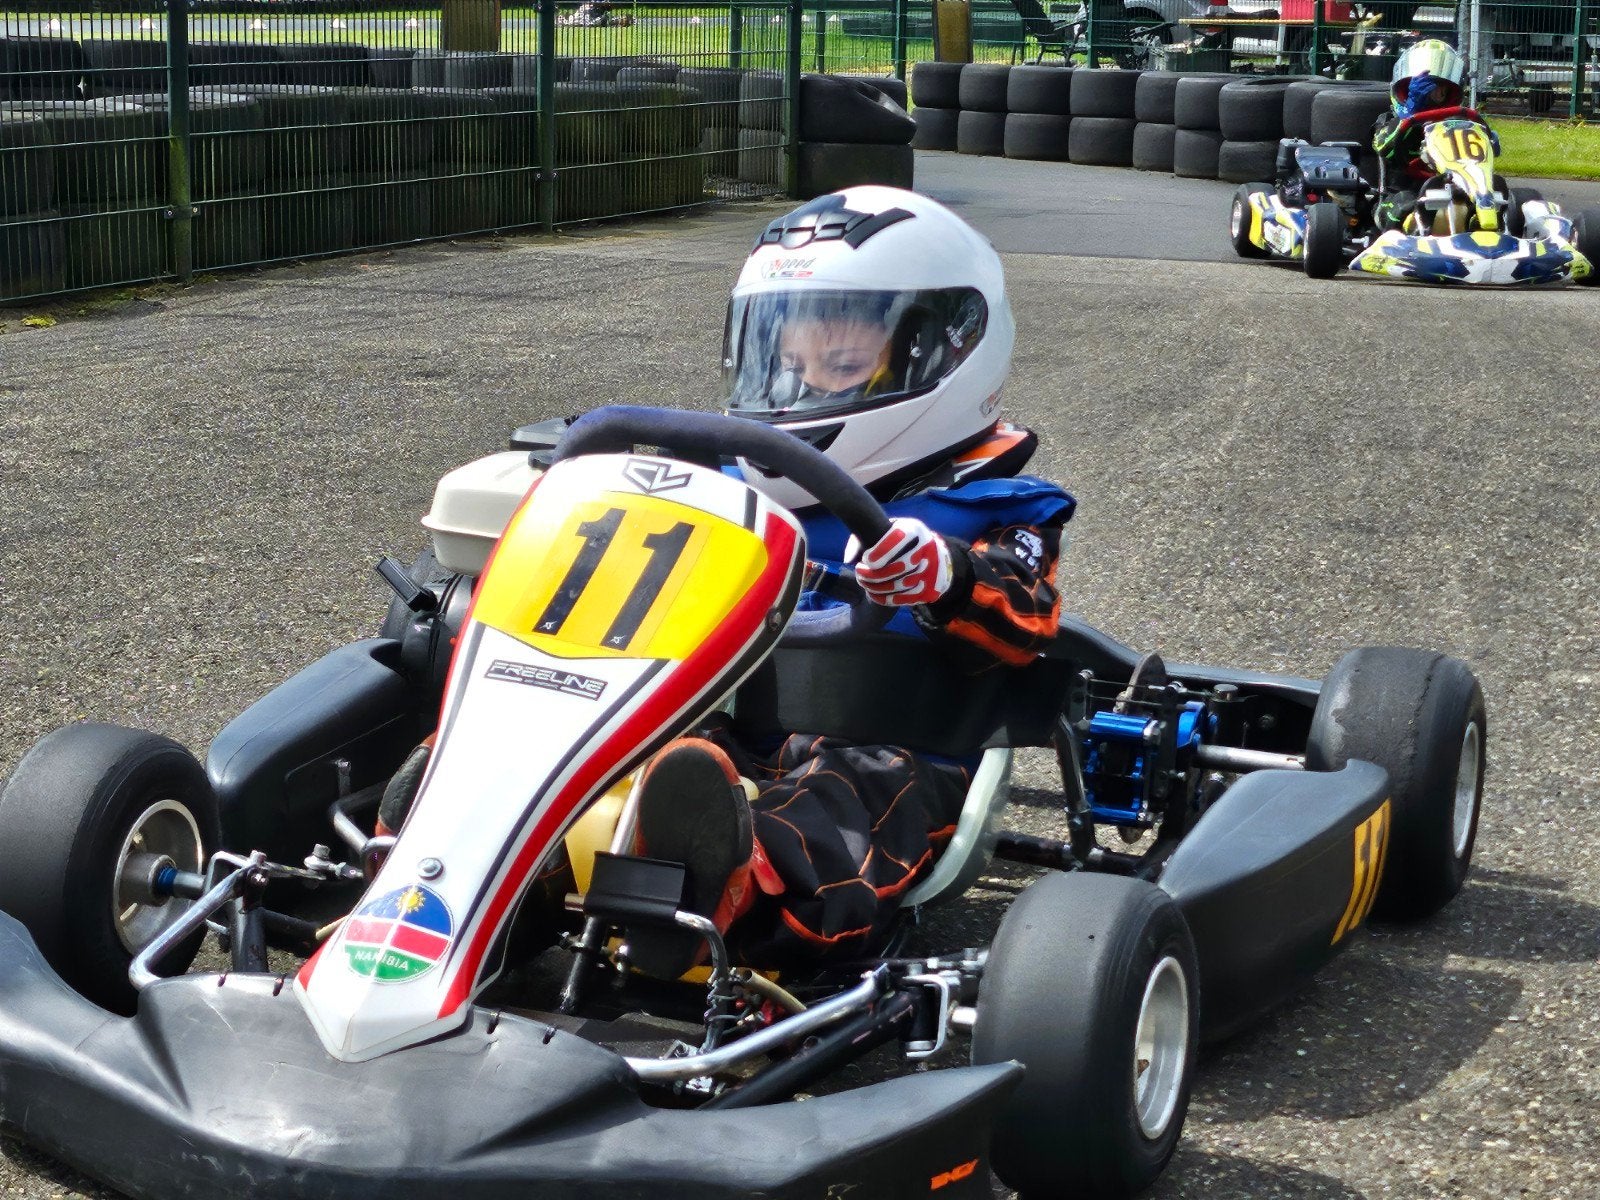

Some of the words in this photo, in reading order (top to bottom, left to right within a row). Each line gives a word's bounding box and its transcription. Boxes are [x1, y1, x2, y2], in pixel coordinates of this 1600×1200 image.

[1443, 127, 1486, 163] 16
[531, 507, 696, 652] 11
[488, 660, 606, 694] FREELINE
